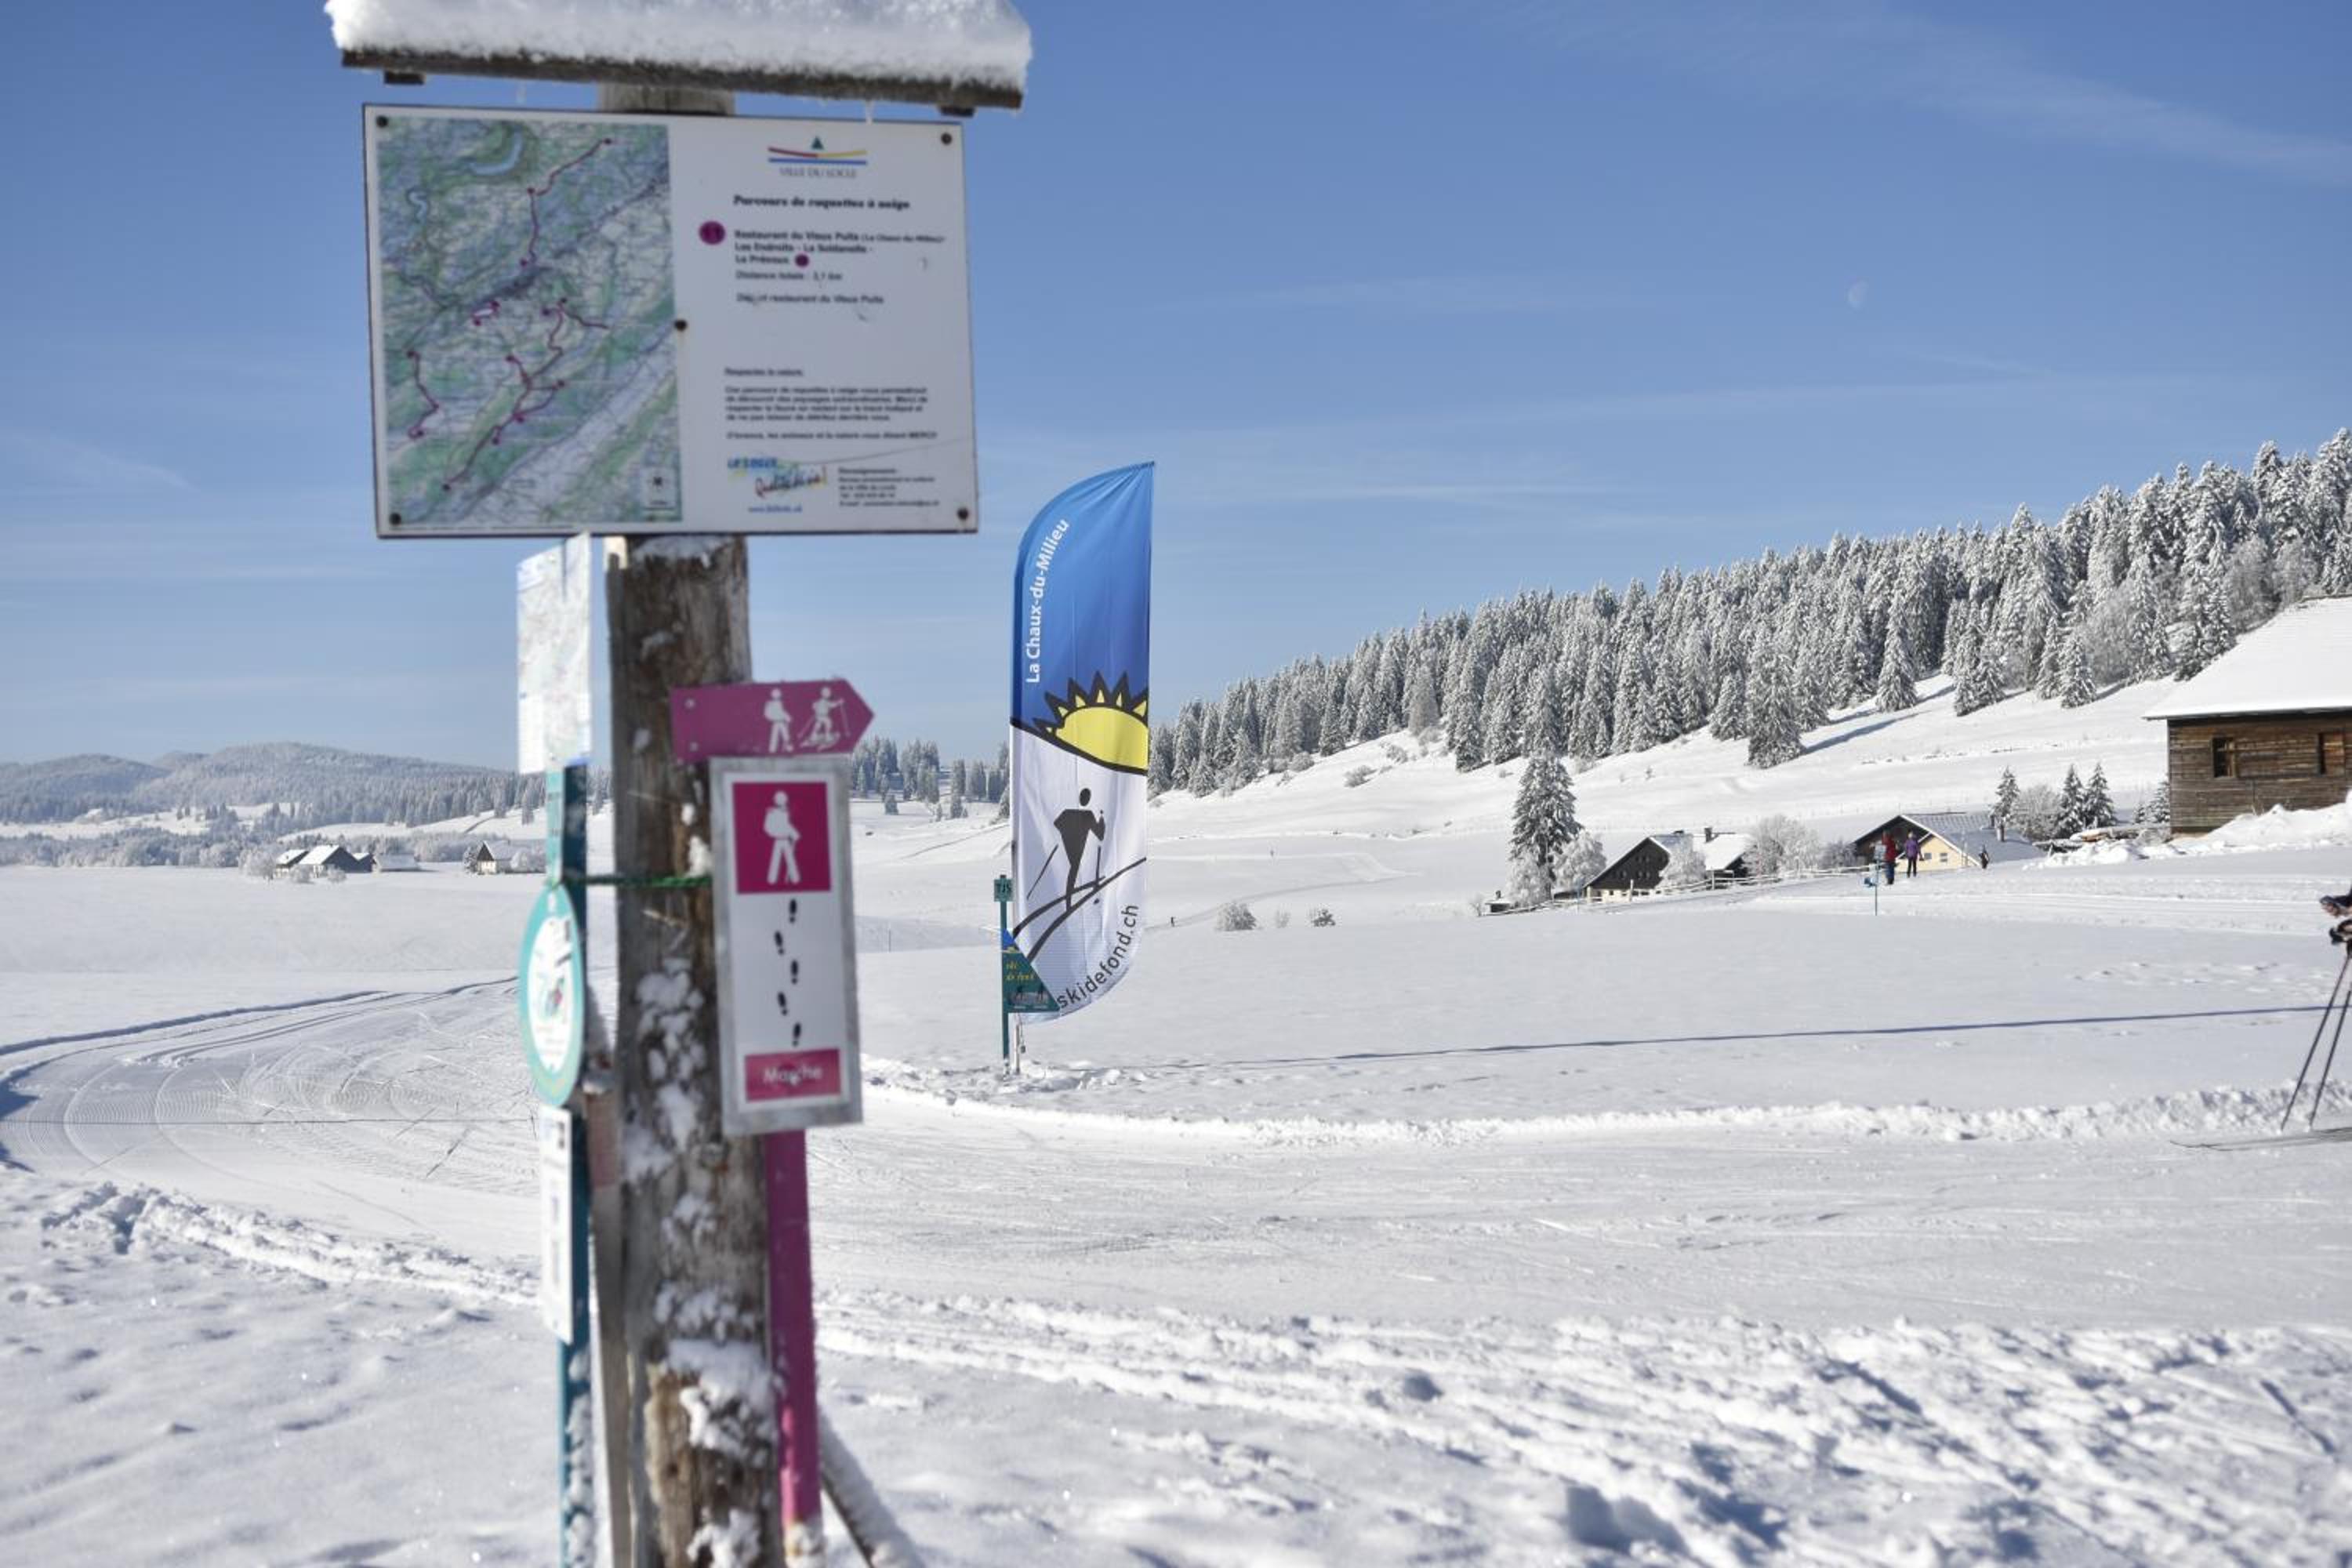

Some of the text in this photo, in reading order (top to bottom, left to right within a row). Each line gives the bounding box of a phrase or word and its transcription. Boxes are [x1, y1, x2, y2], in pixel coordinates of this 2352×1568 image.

[733, 194, 787, 206] Parcours
[791, 196, 805, 206] de
[808, 198, 864, 209] raquettes
[878, 198, 910, 211] neige
[735, 230, 788, 239] Restaurant
[791, 230, 804, 240] du
[806, 231, 832, 240] Vieux
[836, 232, 858, 241] Puits
[1026, 518, 1069, 683] La Chaux-du-Milieu
[1056, 905, 1138, 1009] skidefond.ch
